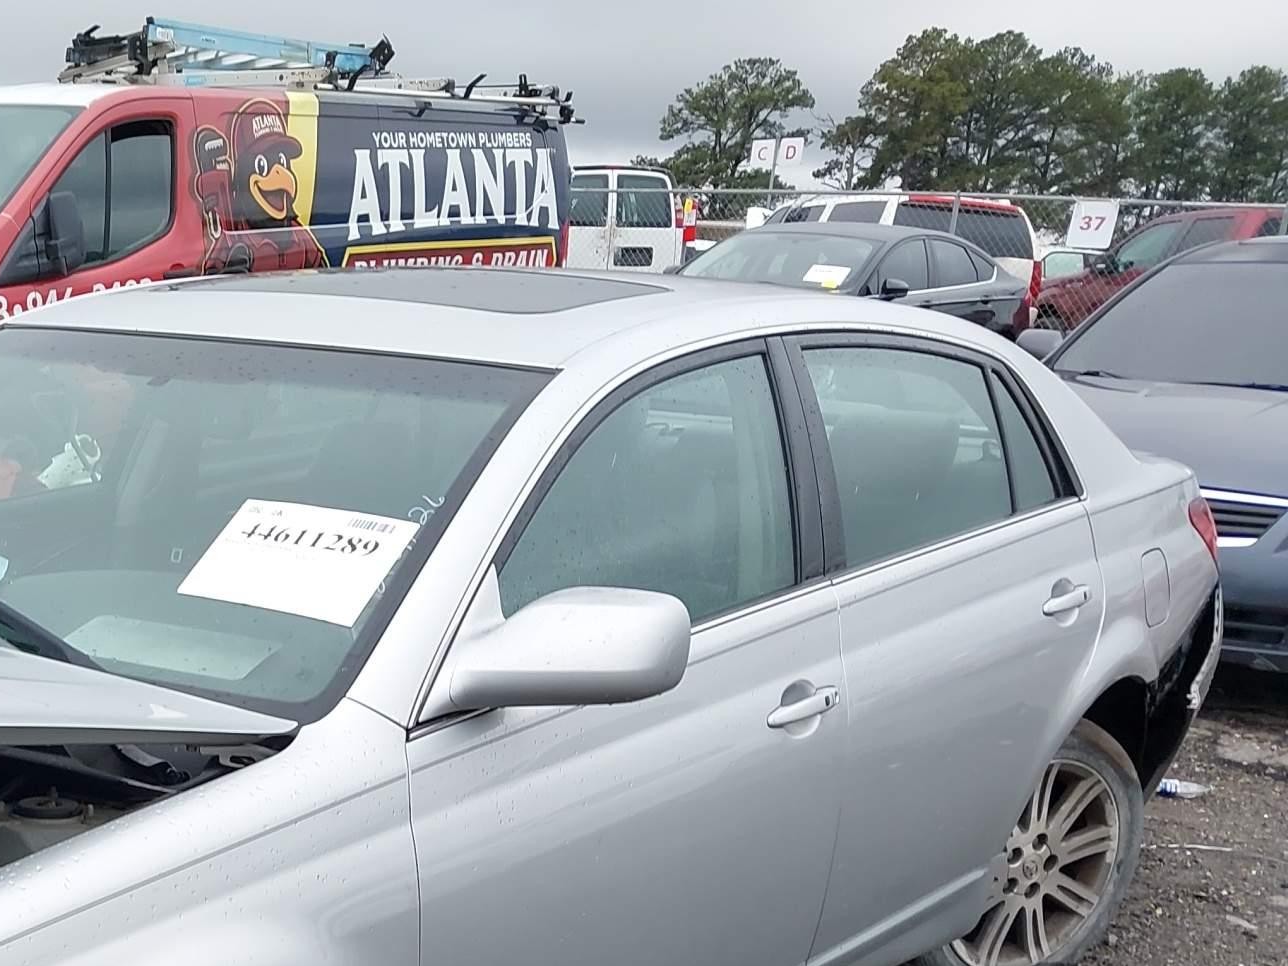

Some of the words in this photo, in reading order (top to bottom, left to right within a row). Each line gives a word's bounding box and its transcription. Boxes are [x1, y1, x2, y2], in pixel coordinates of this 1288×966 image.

[252, 114, 284, 134] ATLANTA
[372, 131, 407, 148] YOUR
[409, 131, 476, 148] HOMETOWN
[478, 131, 532, 148] PLUMBERS
[758, 146, 768, 161] C
[786, 145, 796, 160] D
[348, 149, 560, 241] ATLANTA
[1080, 216, 1106, 231] 37
[242, 523, 380, 556] 44611289
